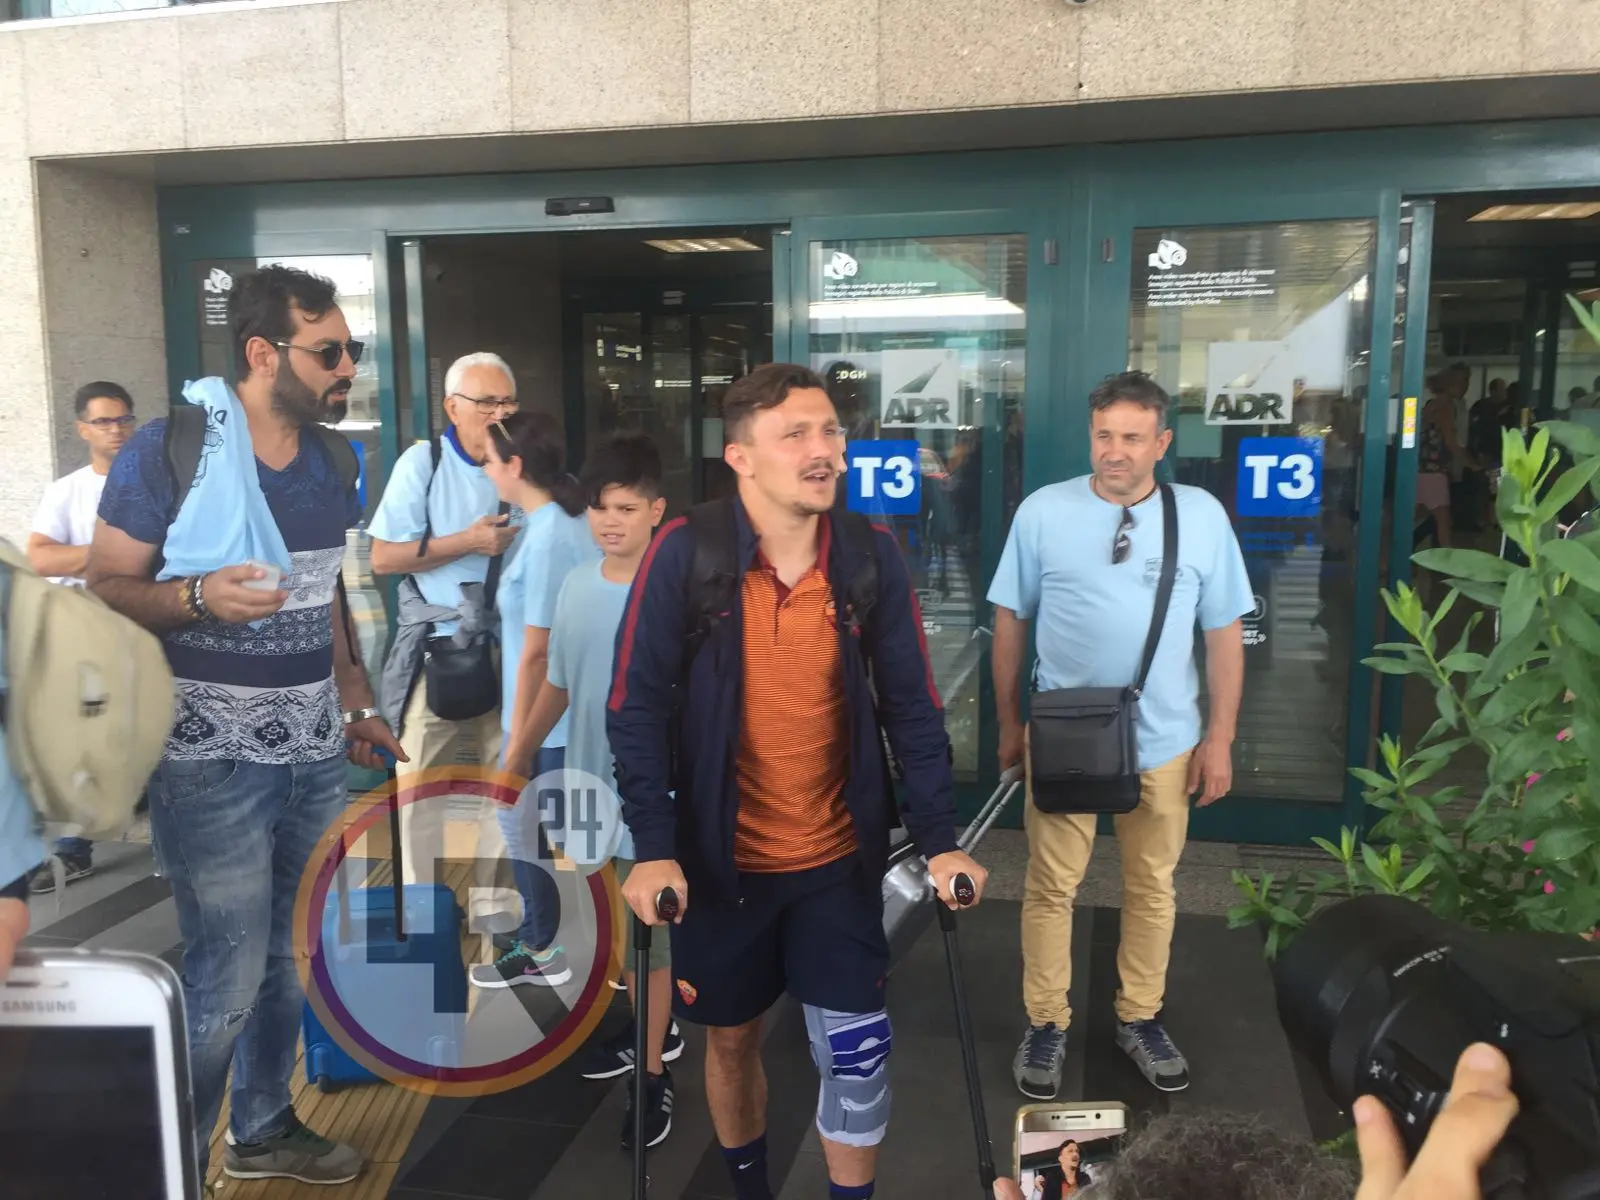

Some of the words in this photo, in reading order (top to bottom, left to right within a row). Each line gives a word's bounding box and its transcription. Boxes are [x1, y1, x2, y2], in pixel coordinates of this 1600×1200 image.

[882, 397, 953, 425] ADR
[1208, 392, 1286, 421] ADR
[852, 455, 916, 499] T3
[1244, 453, 1316, 500] T3
[1, 1000, 78, 1013] SAMSUNG
